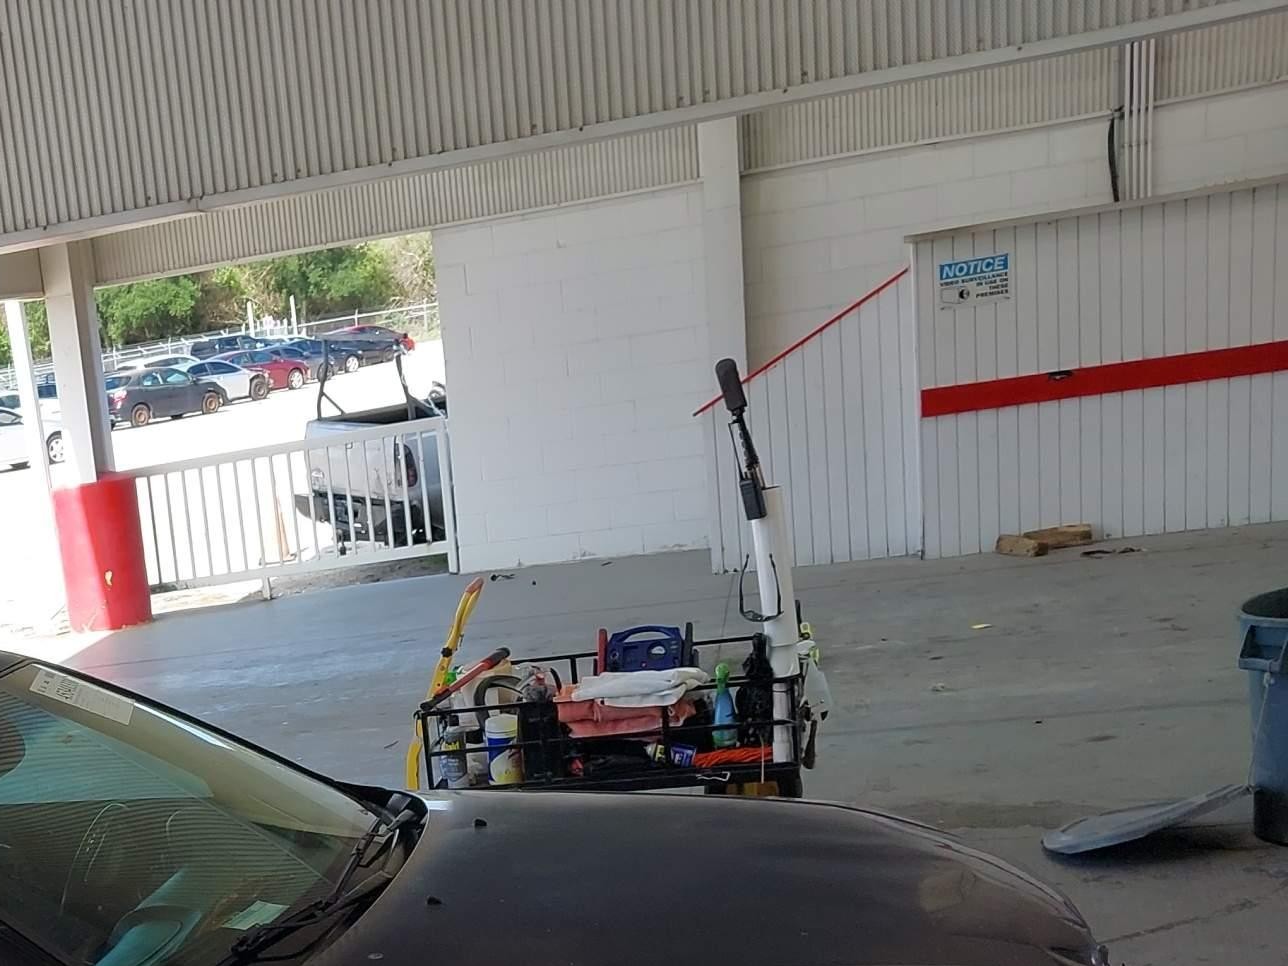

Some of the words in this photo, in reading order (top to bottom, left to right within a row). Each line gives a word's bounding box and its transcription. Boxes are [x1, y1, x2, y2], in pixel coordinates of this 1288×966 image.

[942, 257, 1005, 279] NOTICE
[961, 272, 1008, 284] SURVEILLANCE
[976, 289, 1009, 298] PREMISES
